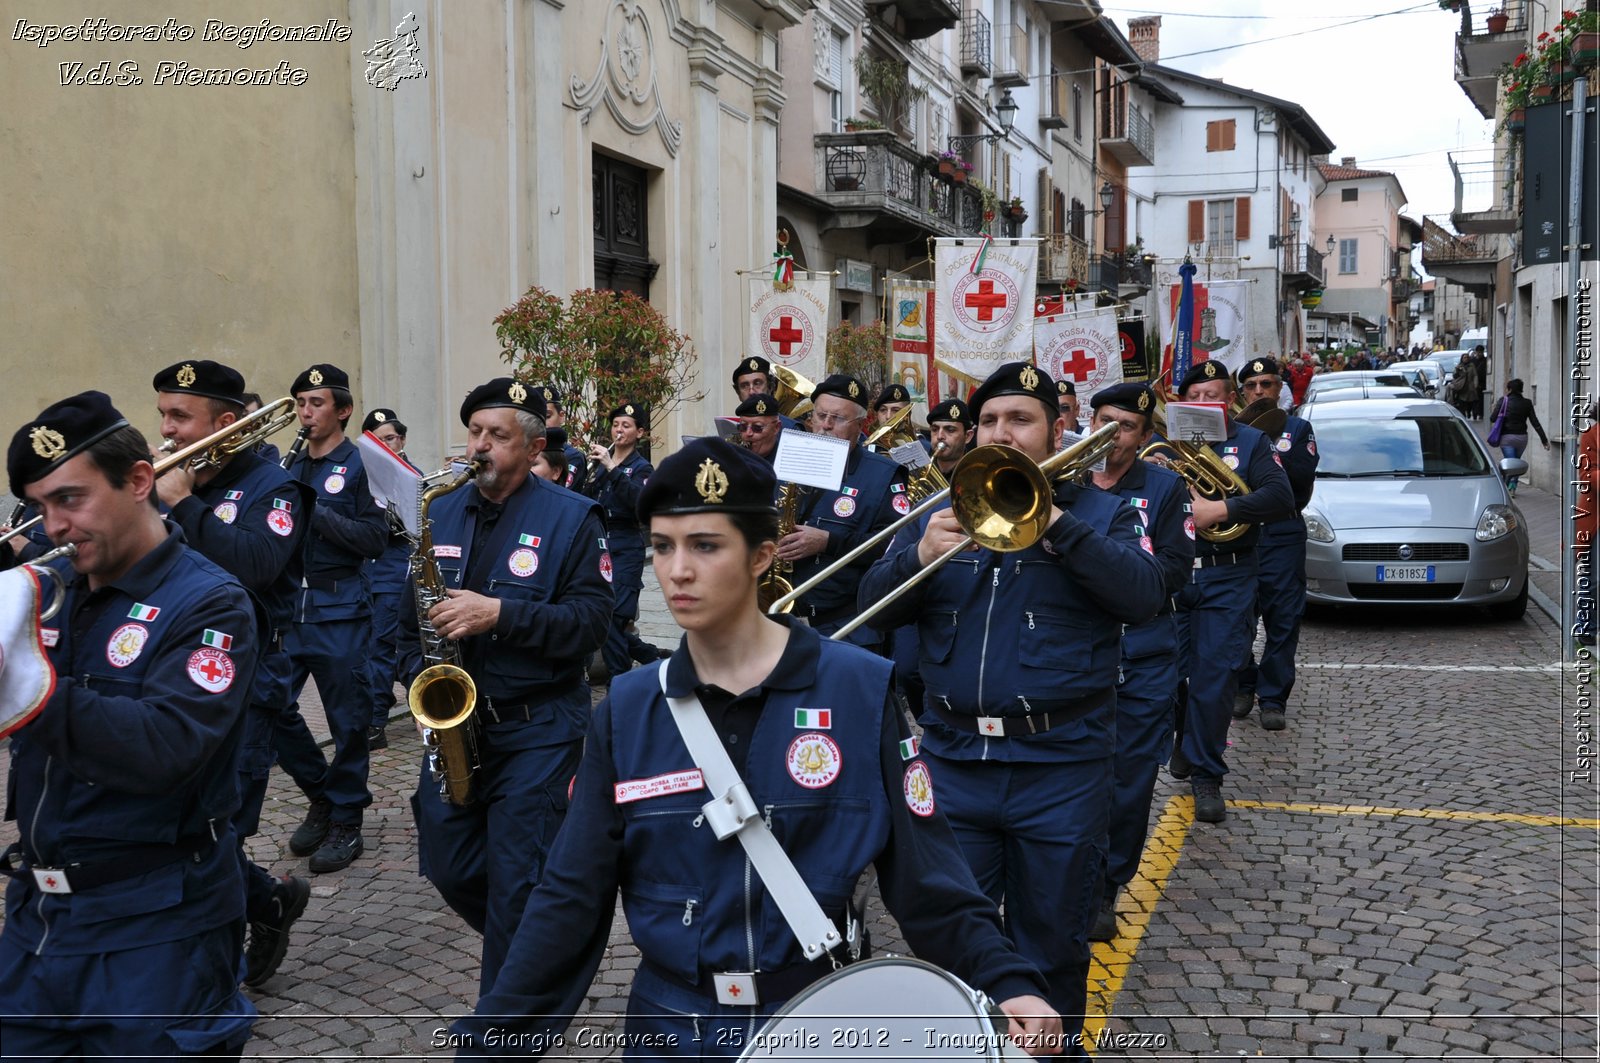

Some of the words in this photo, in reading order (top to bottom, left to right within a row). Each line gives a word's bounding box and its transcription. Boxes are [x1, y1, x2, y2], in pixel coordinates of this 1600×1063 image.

[945, 255, 969, 276] CROCE
[970, 251, 997, 261] RSA
[998, 253, 1029, 274] ITALIANA
[751, 291, 772, 313] CROCE
[800, 289, 826, 316] ITALIANA
[954, 281, 969, 324] CONVENZIONE
[900, 342, 918, 352] PRO
[944, 322, 984, 350] COMITATO
[985, 330, 1017, 350] LOCALE
[1016, 323, 1024, 332] DI
[1041, 337, 1058, 364] CROCE
[1059, 328, 1085, 340] ROSSA
[1088, 329, 1114, 354] ITALIANA
[939, 350, 958, 359] SAN
[959, 350, 1000, 360] GIORGIO
[790, 743, 799, 763] CROCE
[821, 738, 837, 762] ITALIANA
[640, 787, 659, 795] CORPO
[663, 782, 689, 790] MILITARE
[651, 779, 669, 787] ROSSA
[673, 774, 700, 782] ITALIANA
[795, 771, 833, 784] FANFARA
